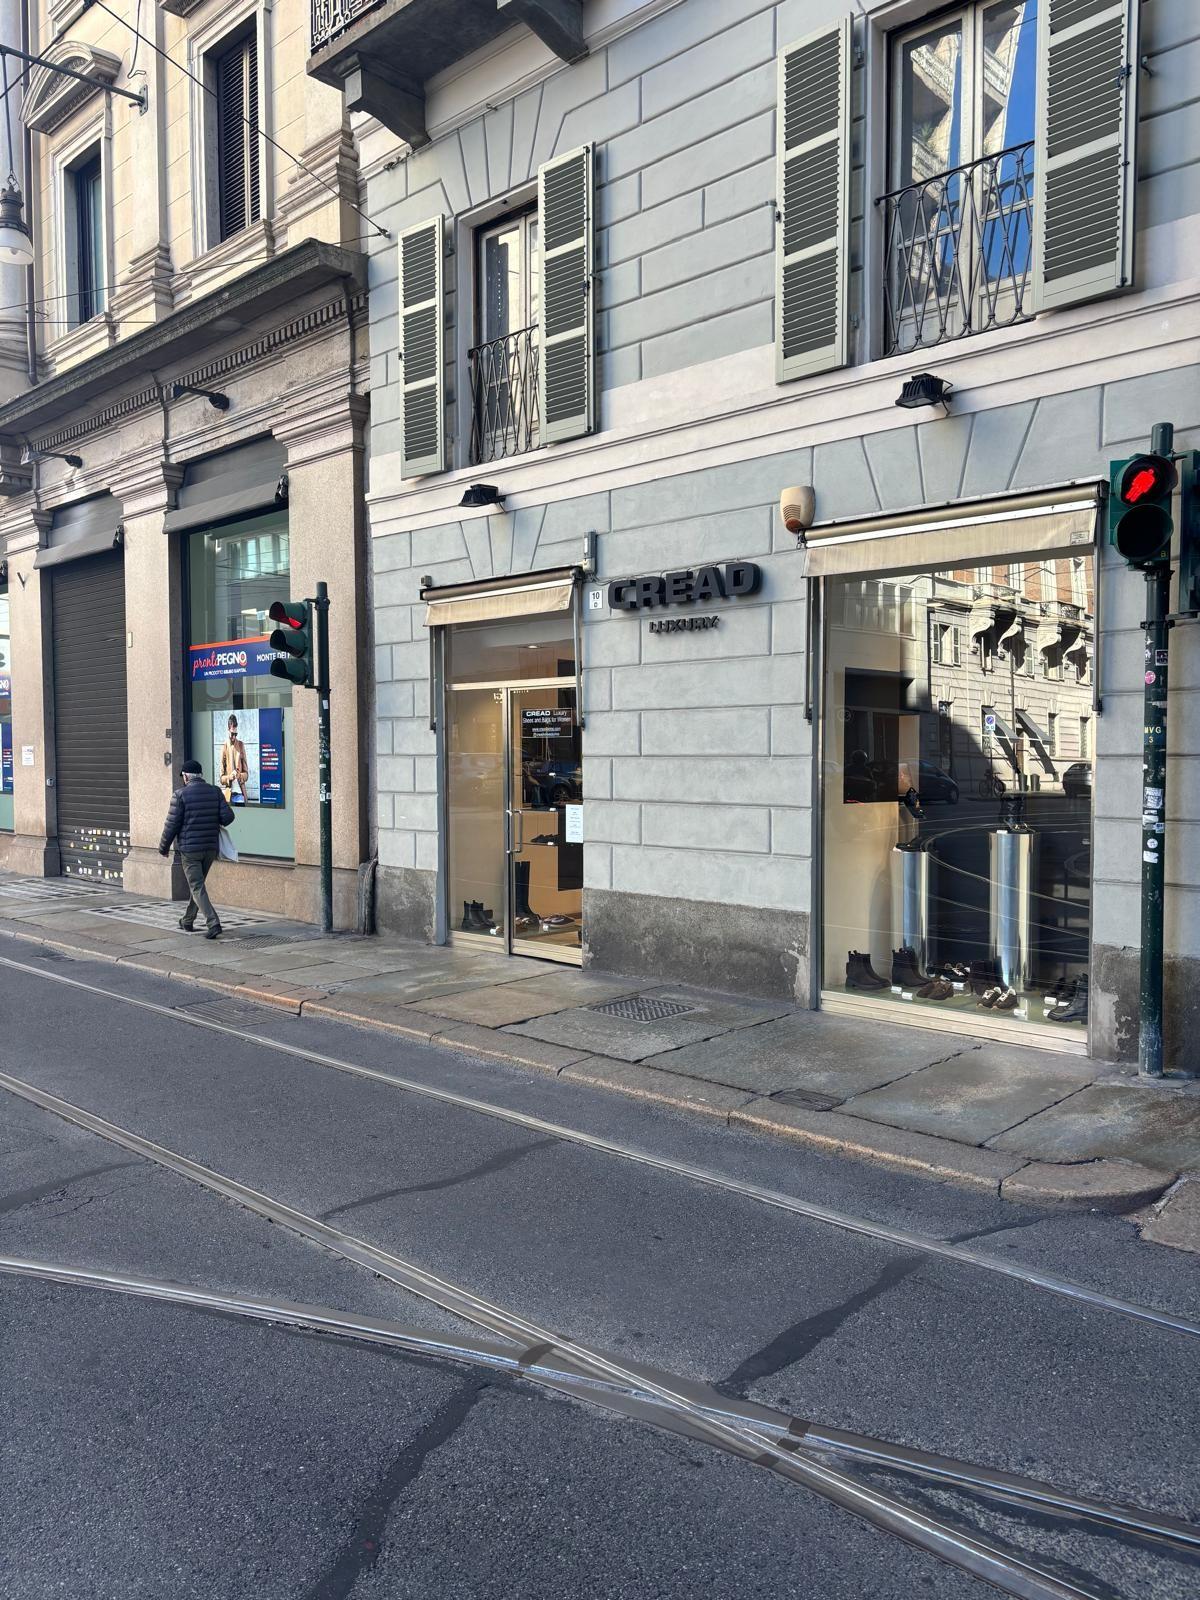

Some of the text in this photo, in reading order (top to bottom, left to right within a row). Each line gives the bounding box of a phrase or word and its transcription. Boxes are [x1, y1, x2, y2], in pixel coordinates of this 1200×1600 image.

[608, 562, 762, 609] CREAD
[592, 591, 600, 600] 10
[649, 616, 720, 633] LUXURY
[256, 652, 277, 662] MONTE
[276, 651, 287, 659] DEI
